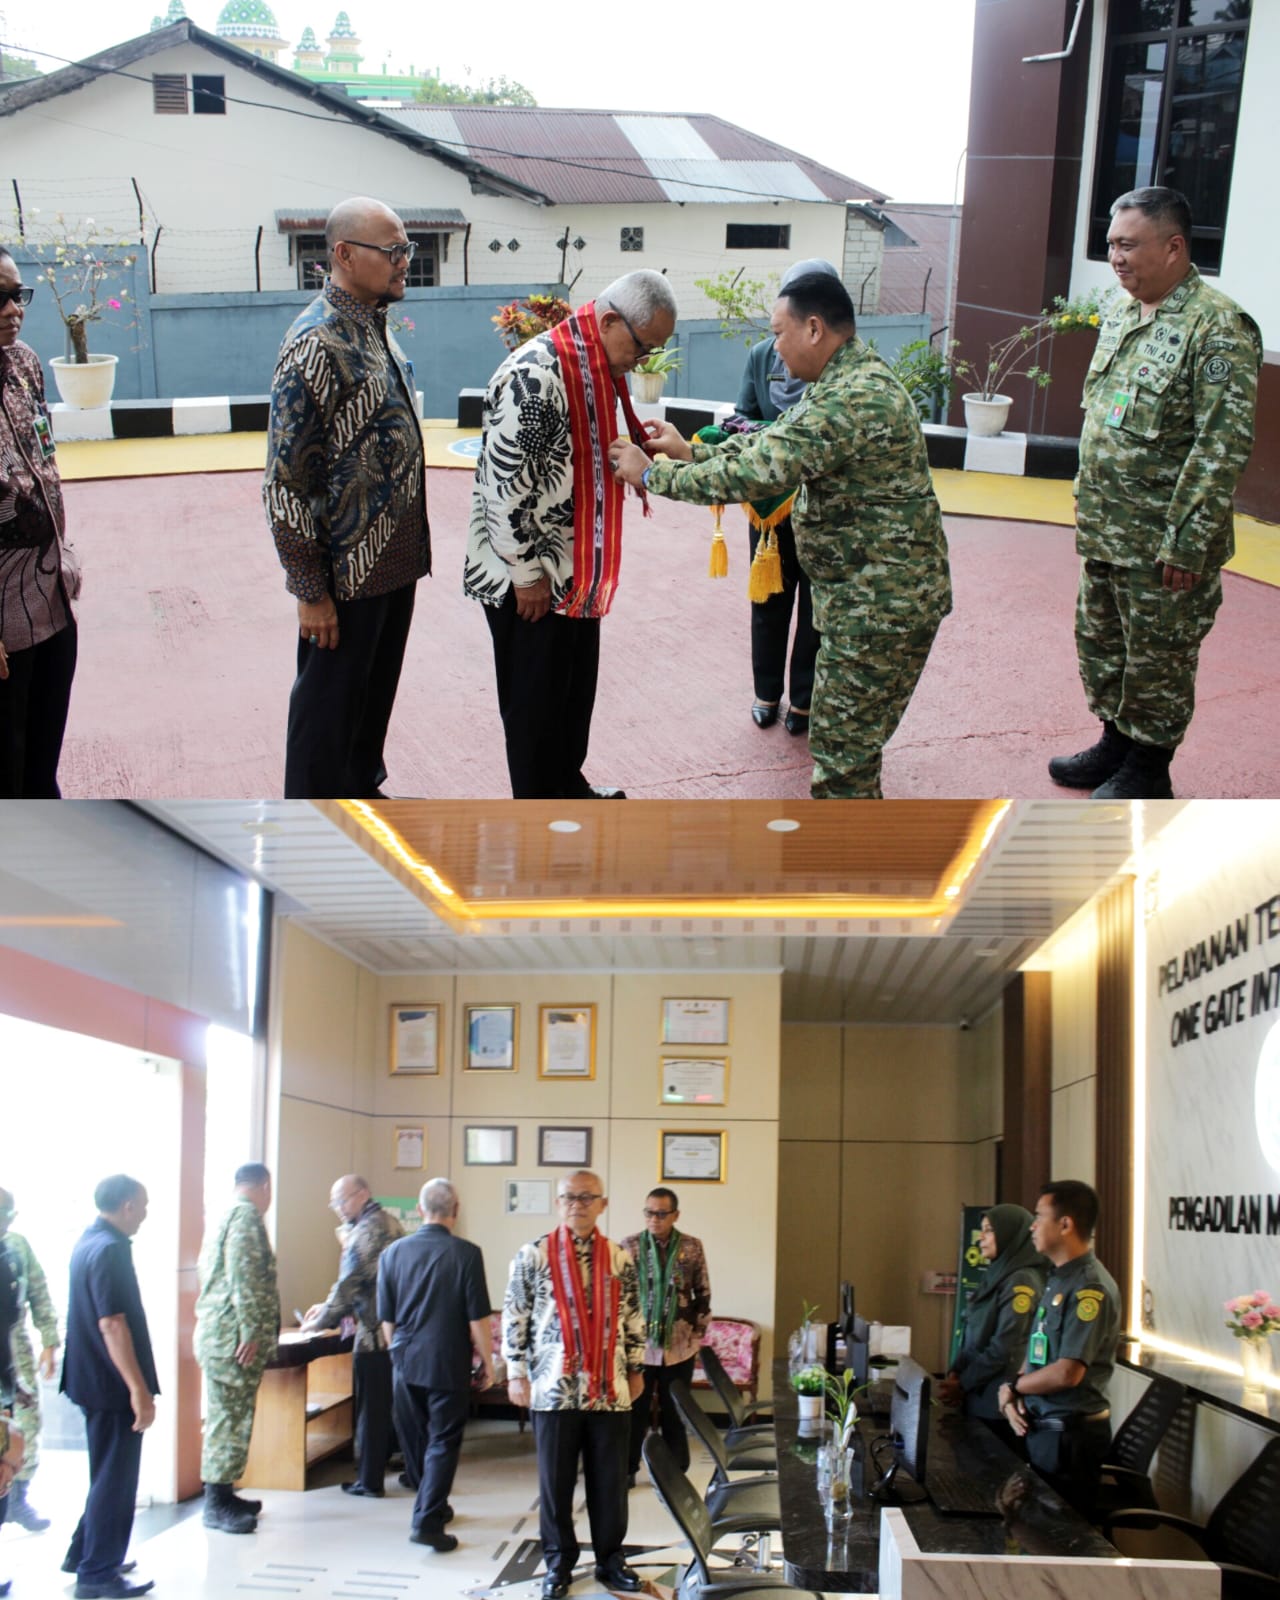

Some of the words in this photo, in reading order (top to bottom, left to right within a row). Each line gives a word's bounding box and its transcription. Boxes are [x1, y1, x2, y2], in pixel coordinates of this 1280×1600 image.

[1144, 343, 1158, 357] TNI
[1159, 351, 1176, 364] AD
[1158, 913, 1249, 997] PELAYANAN
[1171, 1001, 1201, 1048] ONE
[1204, 979, 1247, 1034] GATE
[1168, 1195, 1260, 1235] PENGADILAN
